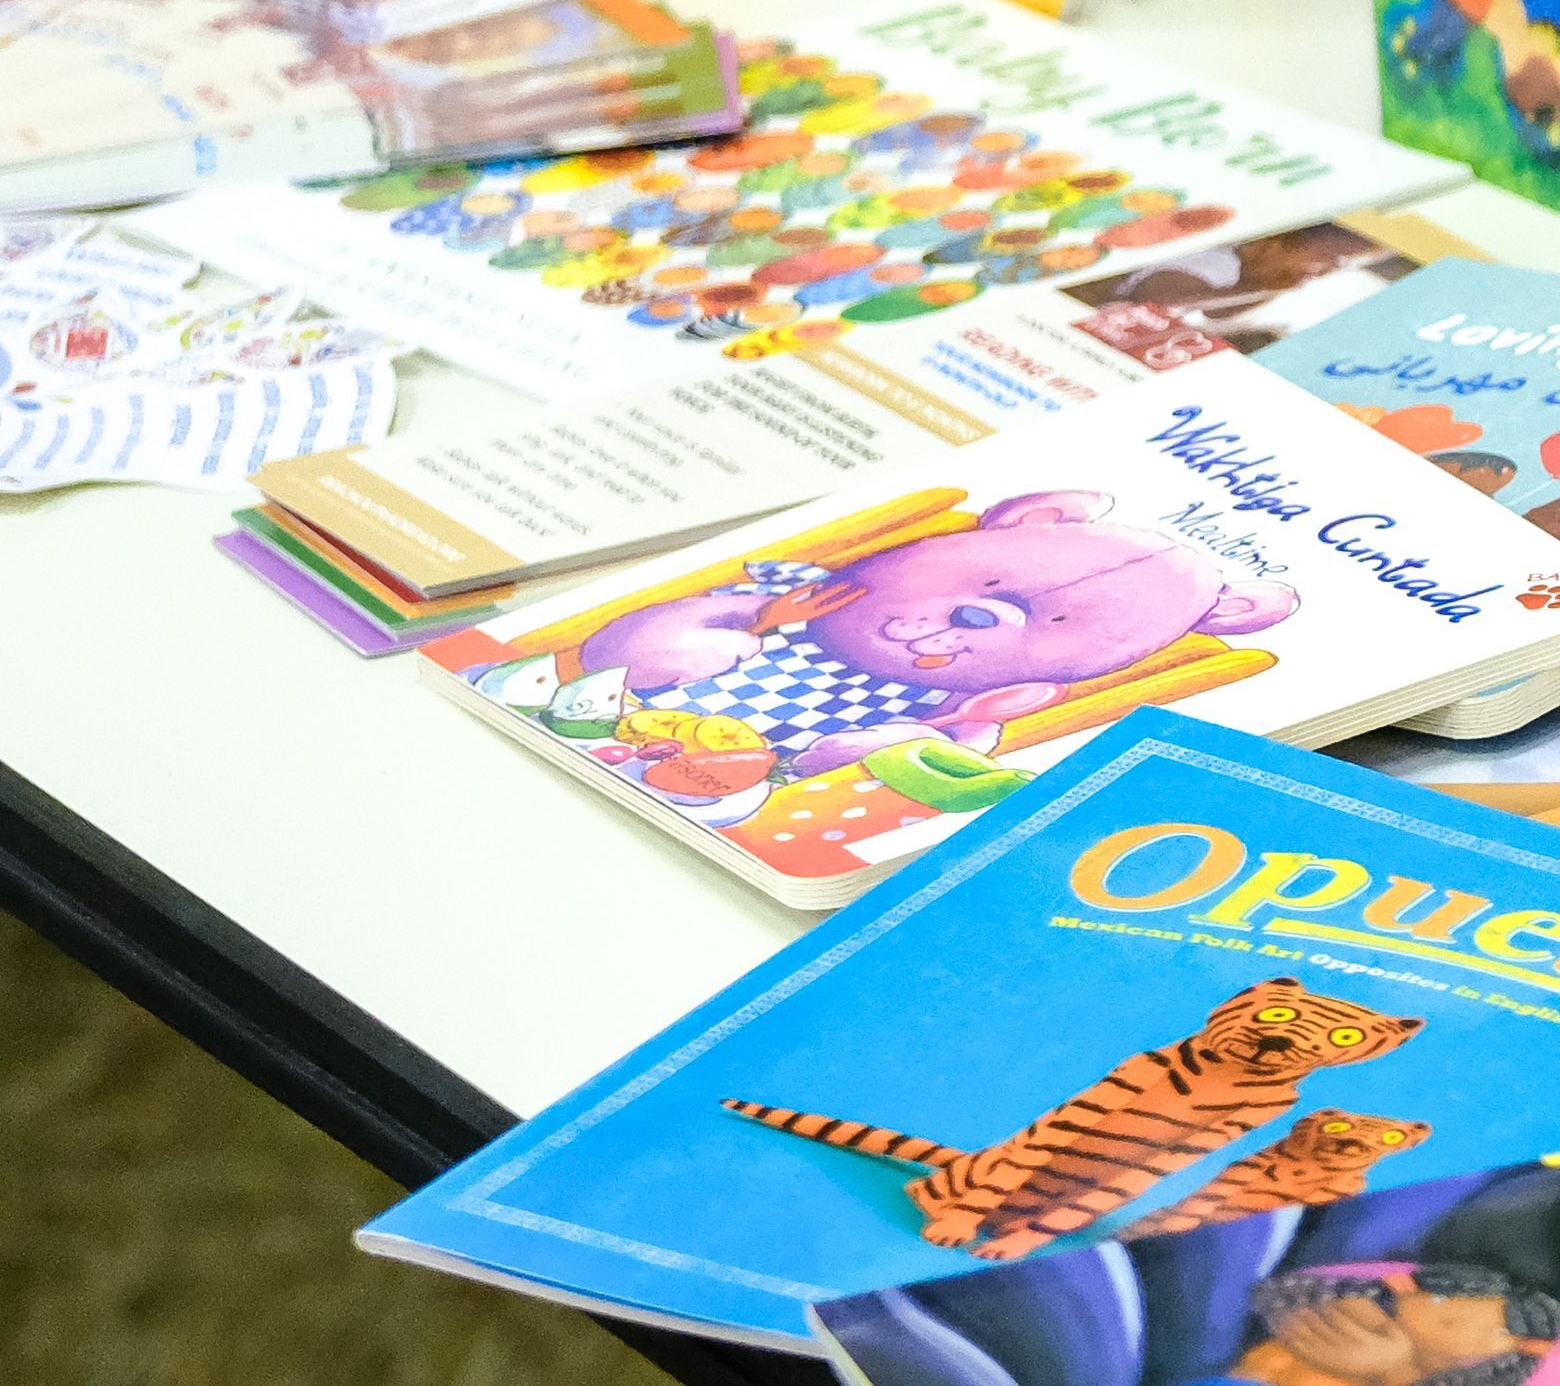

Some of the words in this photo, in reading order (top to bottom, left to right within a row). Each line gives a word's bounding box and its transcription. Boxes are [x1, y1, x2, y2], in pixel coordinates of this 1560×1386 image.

[1145, 404, 1315, 524] Wakhtiga
[1158, 502, 1292, 579] Mealtime
[1047, 914, 1185, 944] Mexican
[1190, 931, 1252, 957] Folk
[1255, 941, 1305, 965] Art
[1307, 952, 1452, 996] Opposites
[1453, 984, 1484, 1003] in
